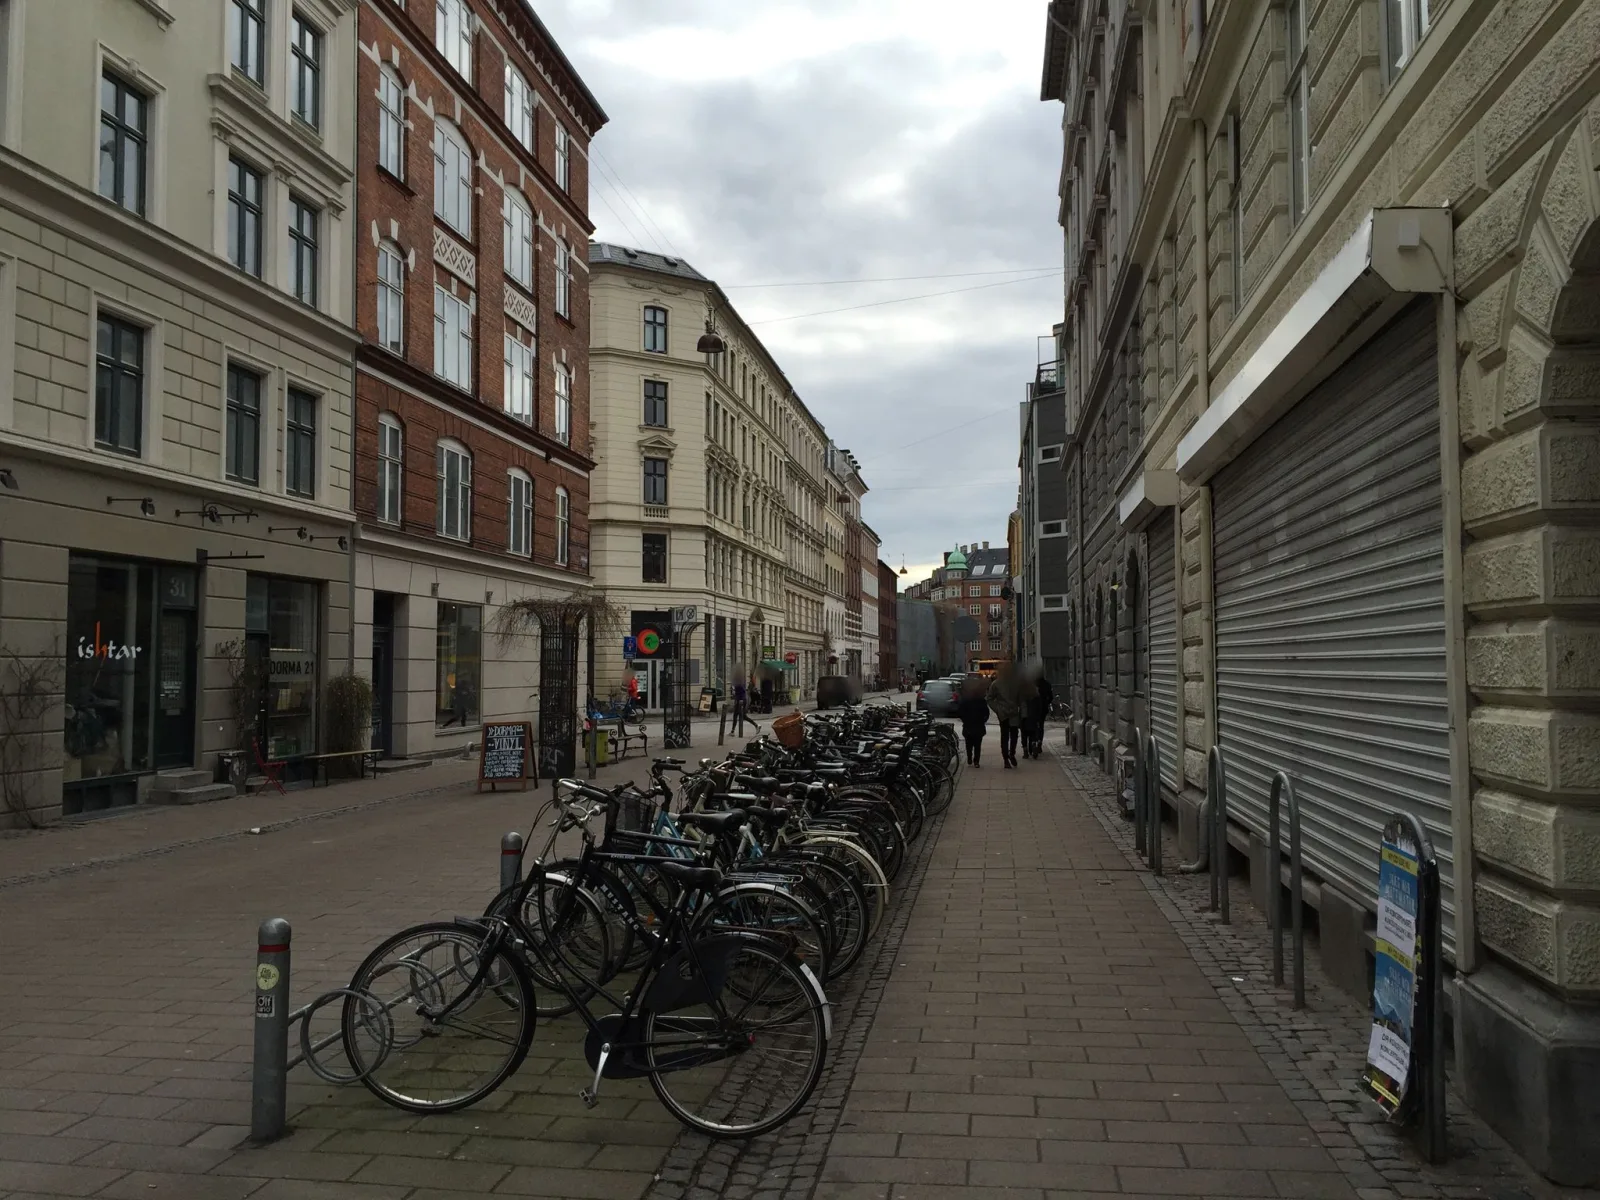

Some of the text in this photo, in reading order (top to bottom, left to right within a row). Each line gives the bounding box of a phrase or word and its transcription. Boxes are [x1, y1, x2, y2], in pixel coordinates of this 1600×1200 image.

[169, 577, 187, 598] 31
[77, 620, 142, 667] ishtar
[269, 660, 314, 675] DORMA 21
[599, 884, 640, 931] MUSTANG
